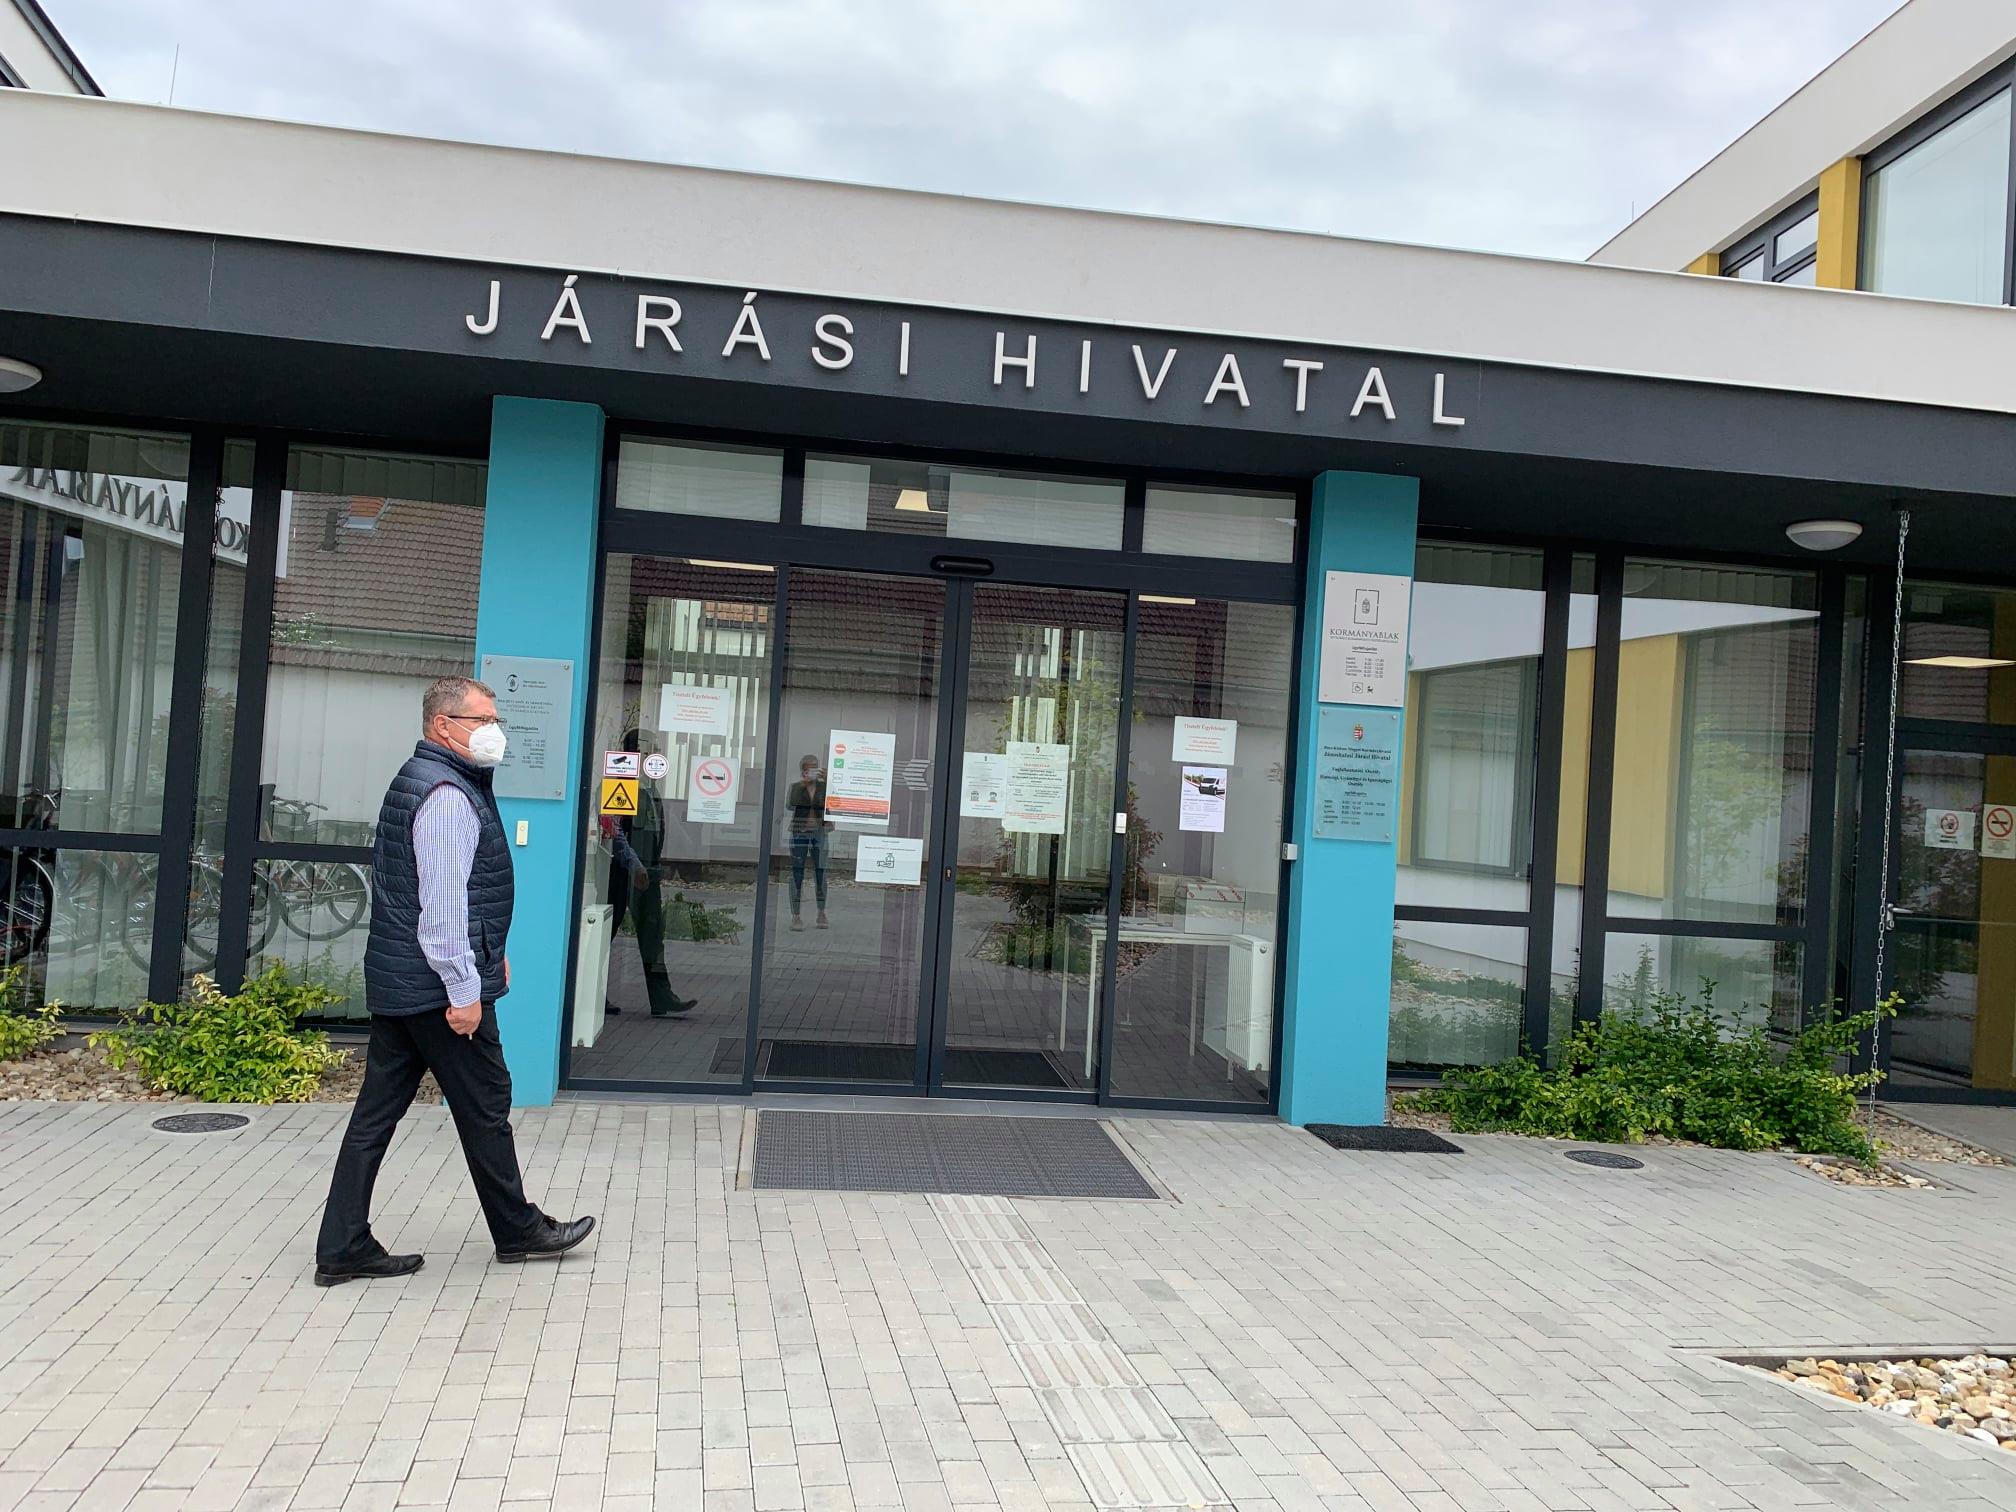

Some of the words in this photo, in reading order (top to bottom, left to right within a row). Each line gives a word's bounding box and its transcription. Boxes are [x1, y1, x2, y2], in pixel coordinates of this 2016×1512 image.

[465, 274, 911, 376] JÁRÁSI
[993, 331, 1466, 426] HIVATAL
[1330, 628, 1400, 640] KORMÁNYABLAK
